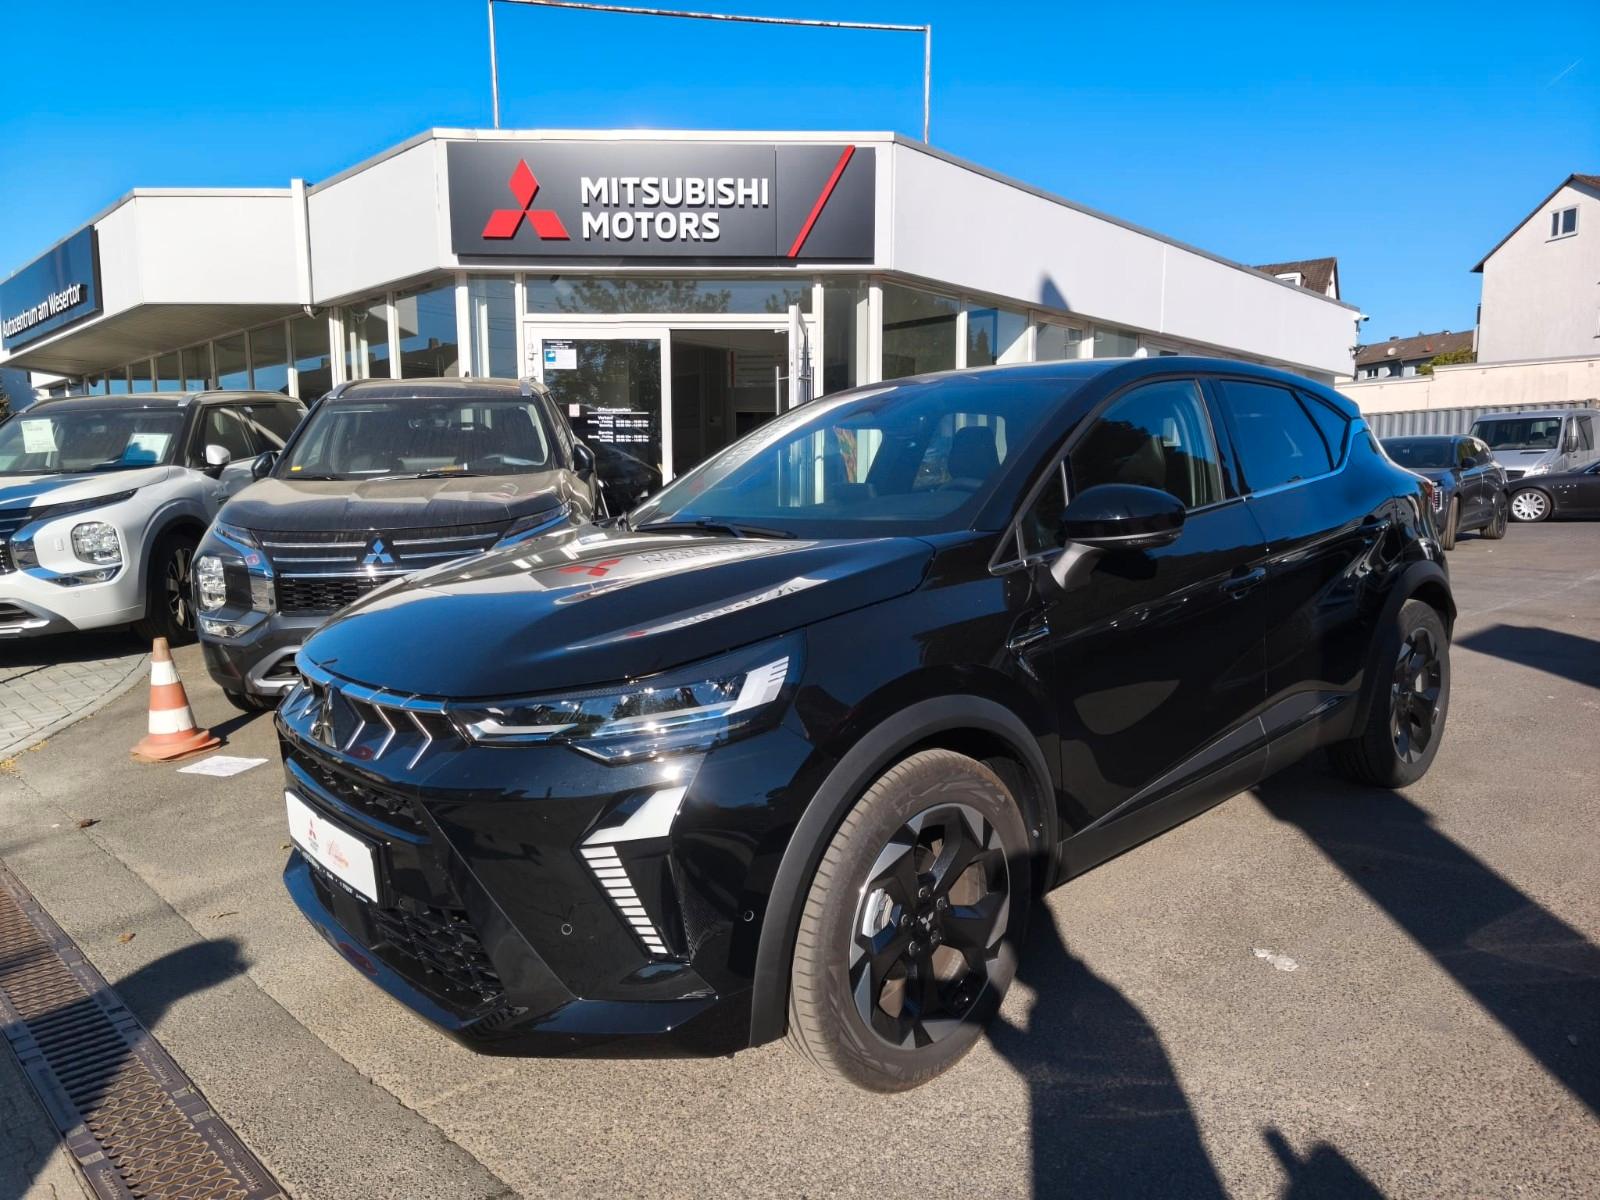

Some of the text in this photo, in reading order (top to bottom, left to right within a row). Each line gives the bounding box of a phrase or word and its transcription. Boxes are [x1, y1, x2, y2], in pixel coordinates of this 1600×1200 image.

[580, 176, 770, 206] MITSUBISHI
[582, 211, 721, 240] MOTORS
[37, 301, 49, 321] am
[48, 283, 81, 316] Wesertor
